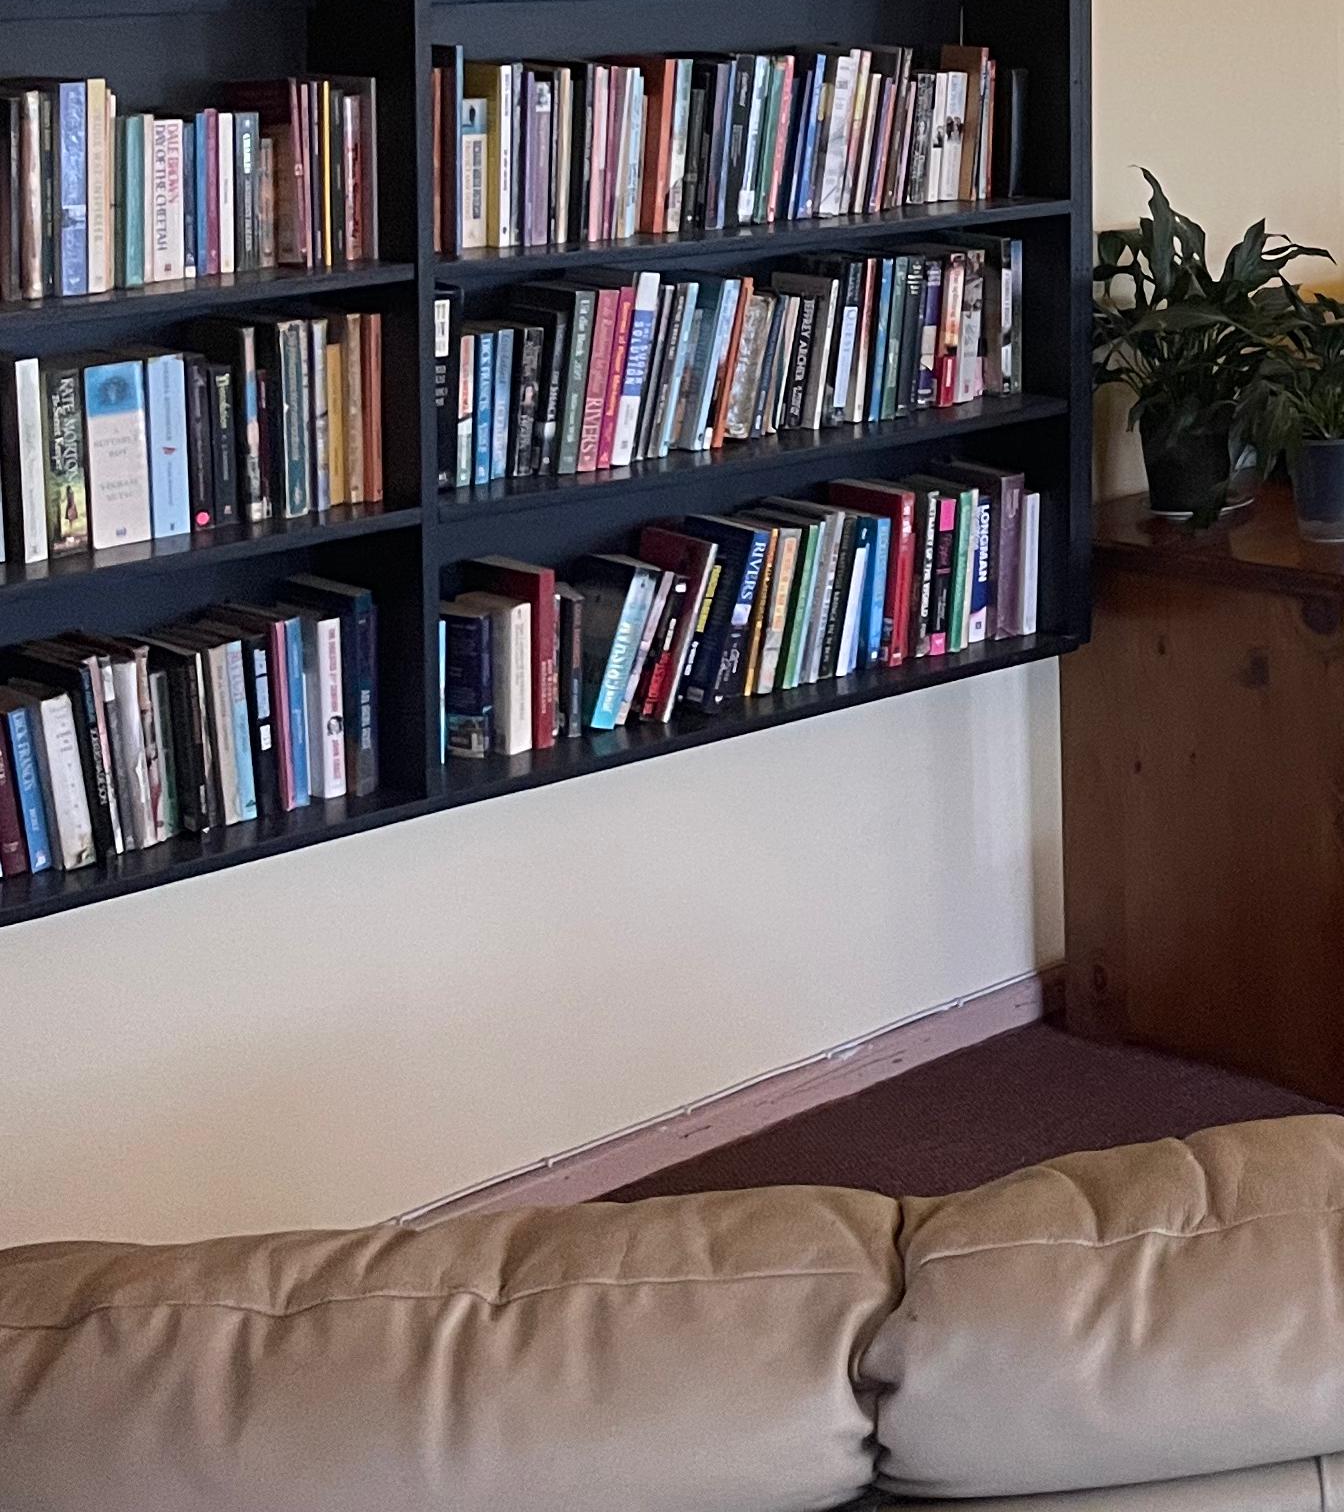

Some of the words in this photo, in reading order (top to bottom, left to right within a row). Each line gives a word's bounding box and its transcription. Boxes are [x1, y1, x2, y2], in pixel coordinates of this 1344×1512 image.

[155, 124, 167, 148] DAY
[155, 148, 167, 164] OF
[167, 123, 179, 155] DALE
[156, 164, 167, 194] THE
[167, 157, 180, 205] BROWN
[156, 194, 168, 251] CHEETAH
[800, 299, 815, 337] JEFFREY
[624, 320, 644, 385] SOLUTION
[793, 339, 809, 381] ARCHER
[60, 377, 76, 414] KATE
[546, 381, 559, 422] SHACK
[580, 397, 604, 454] RIVERS
[61, 417, 79, 481] MORTON
[978, 503, 991, 583] LONGMAN
[741, 541, 766, 605] RIVERS
